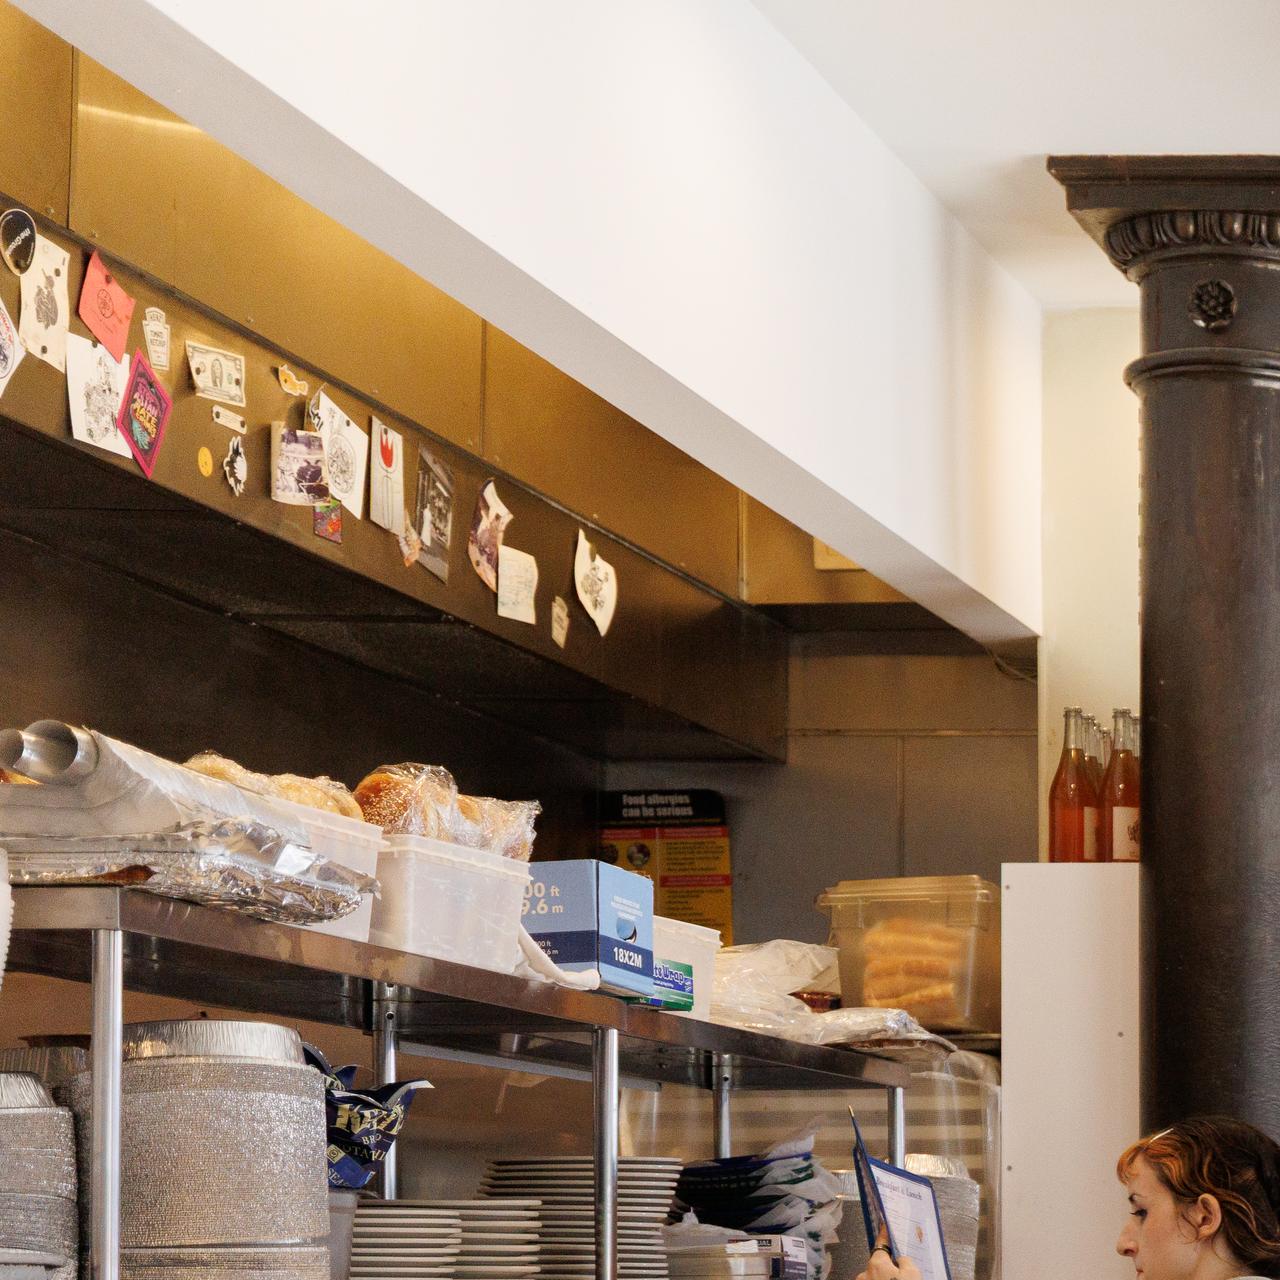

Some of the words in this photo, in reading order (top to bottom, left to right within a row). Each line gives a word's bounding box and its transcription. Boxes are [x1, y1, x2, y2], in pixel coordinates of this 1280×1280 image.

[642, 806, 654, 816] be
[523, 882, 546, 898] 00
[550, 885, 560, 897] ft
[521, 899, 548, 915] 9.6
[552, 904, 564, 913] m
[613, 946, 642, 969] 18X2M
